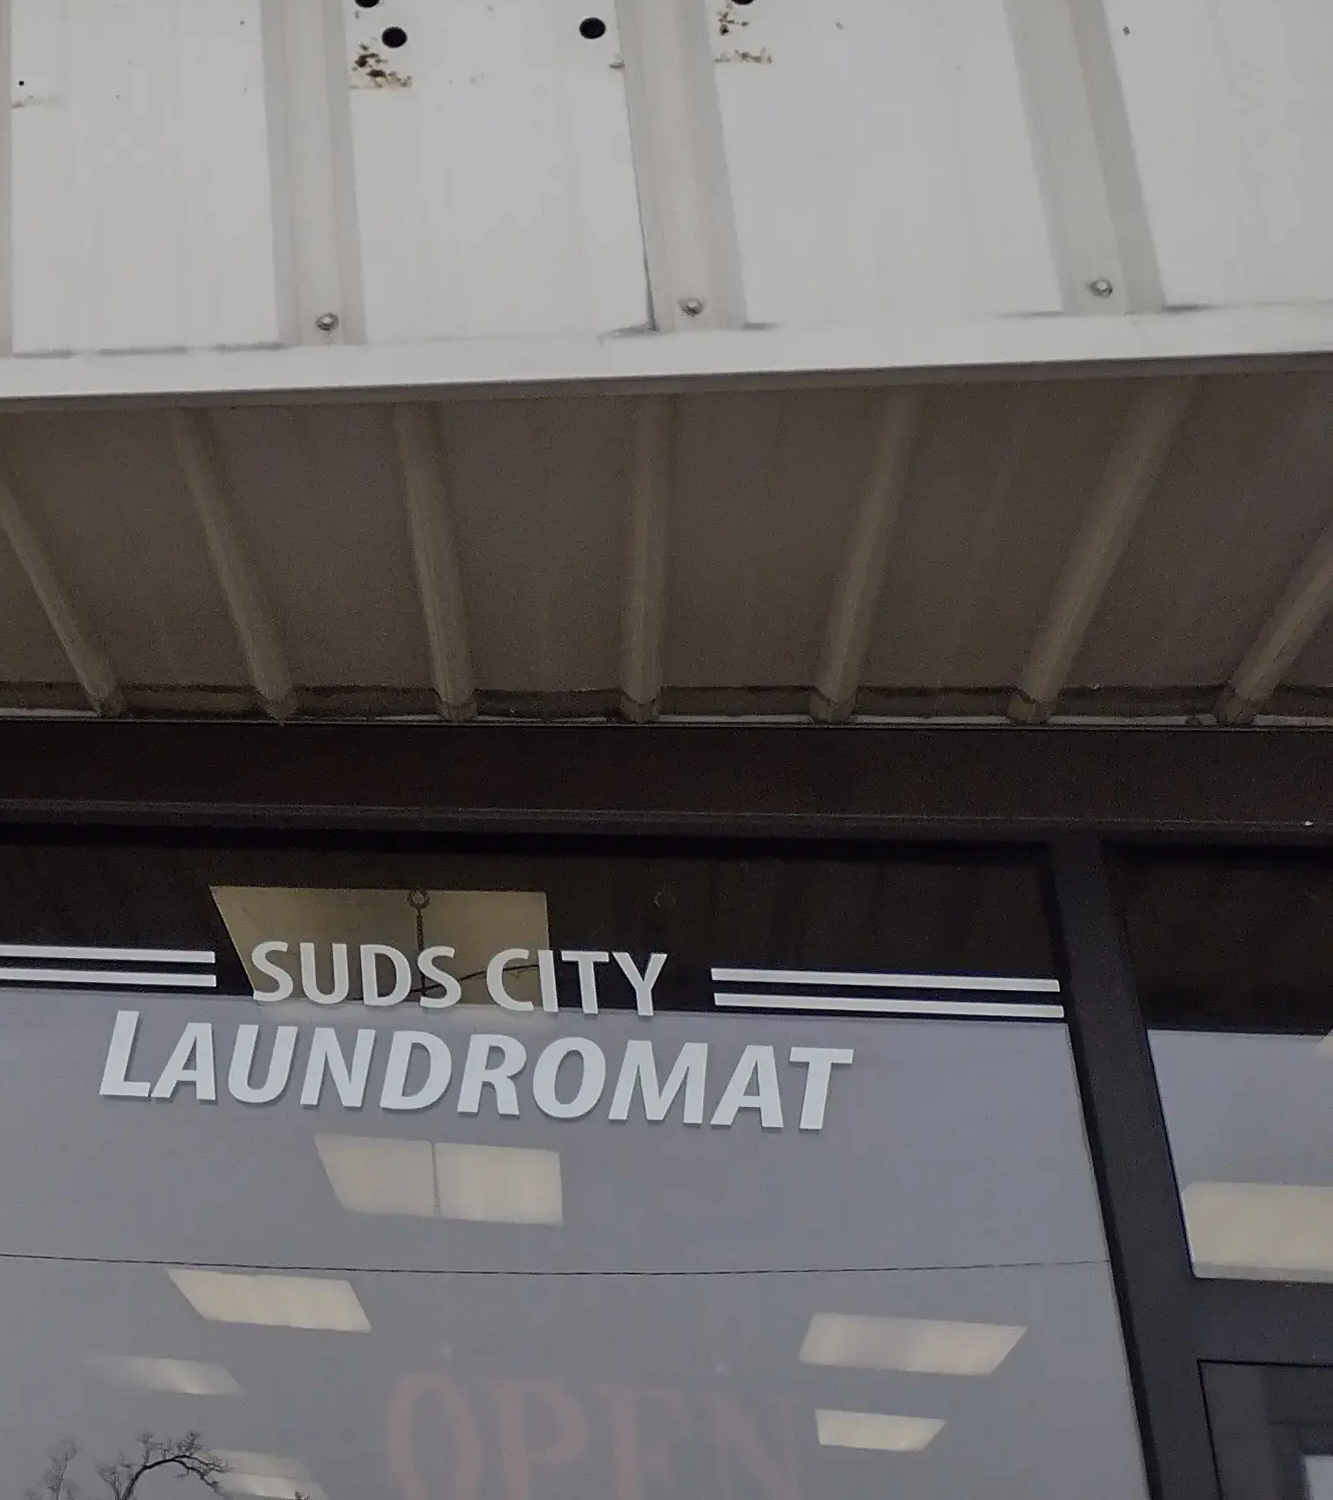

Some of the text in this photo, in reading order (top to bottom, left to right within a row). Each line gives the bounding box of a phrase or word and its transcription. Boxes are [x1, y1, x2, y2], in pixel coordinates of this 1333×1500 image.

[250, 940, 669, 1016] SUDS CITY
[98, 1011, 854, 1131] LAUNDROMAT
[385, 1367, 803, 1500] OPEN
